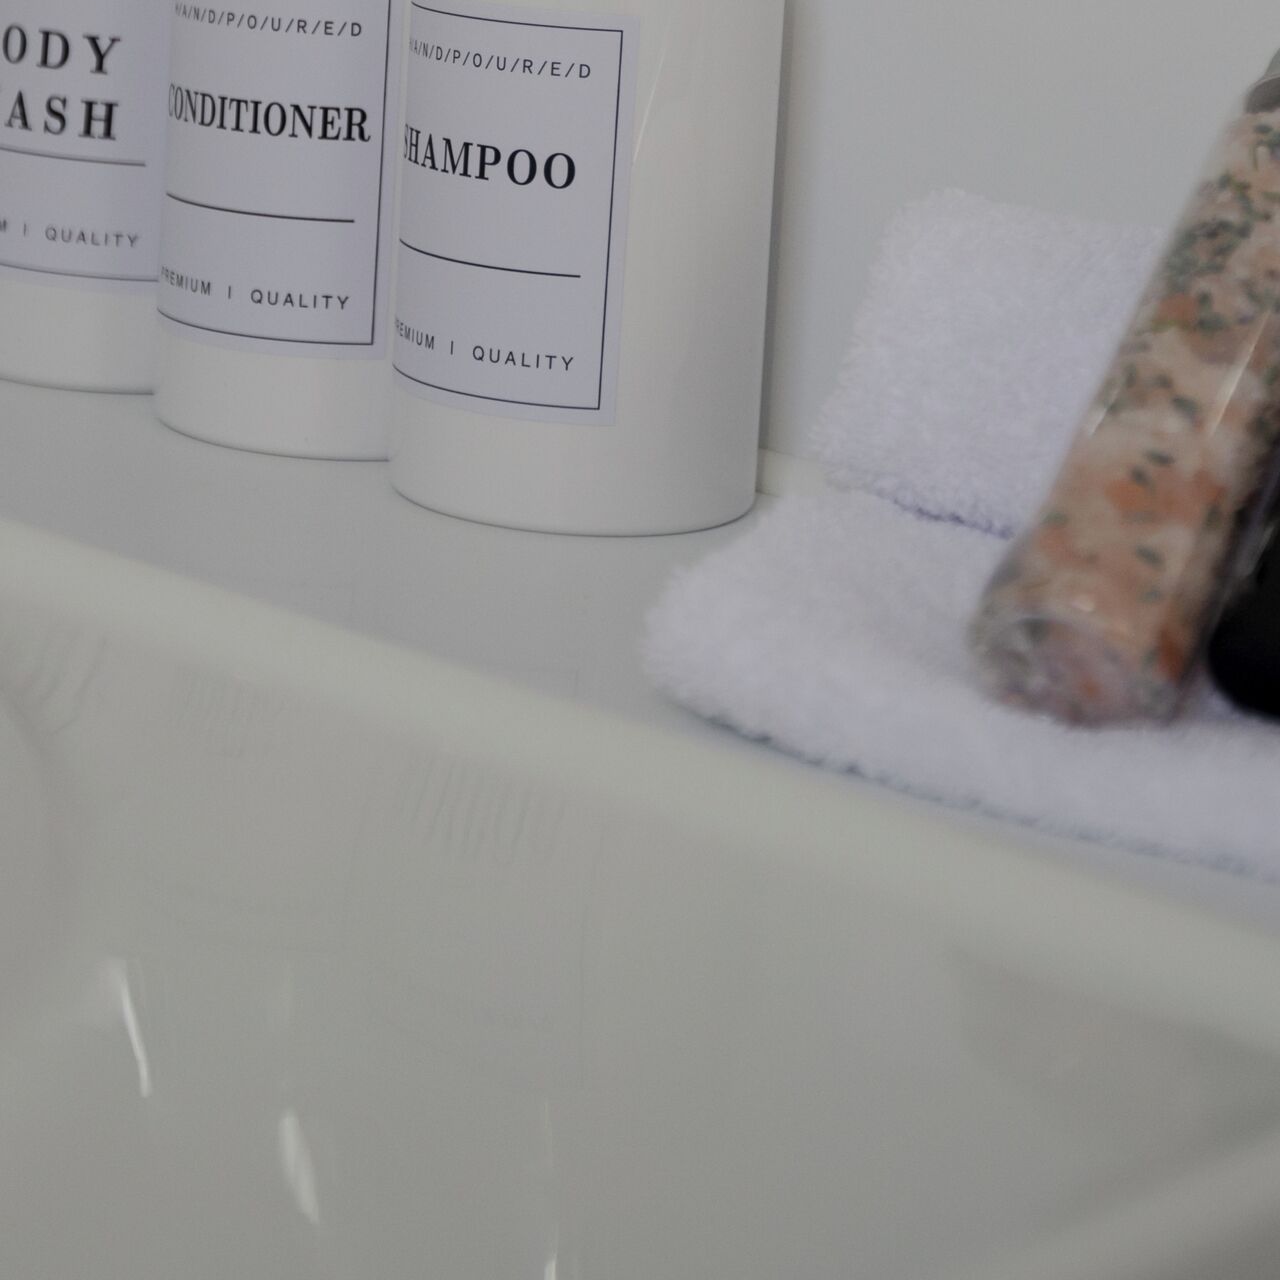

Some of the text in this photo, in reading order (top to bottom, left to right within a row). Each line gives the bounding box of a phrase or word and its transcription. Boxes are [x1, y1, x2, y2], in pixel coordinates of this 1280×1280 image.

[167, 81, 372, 143] CONDITIONER
[403, 122, 577, 190] SHAMPOO
[44, 226, 140, 248] QUALITY
[160, 265, 213, 297] PREMIUM
[250, 288, 350, 310] QUALITY
[472, 345, 575, 372] QUALITY
